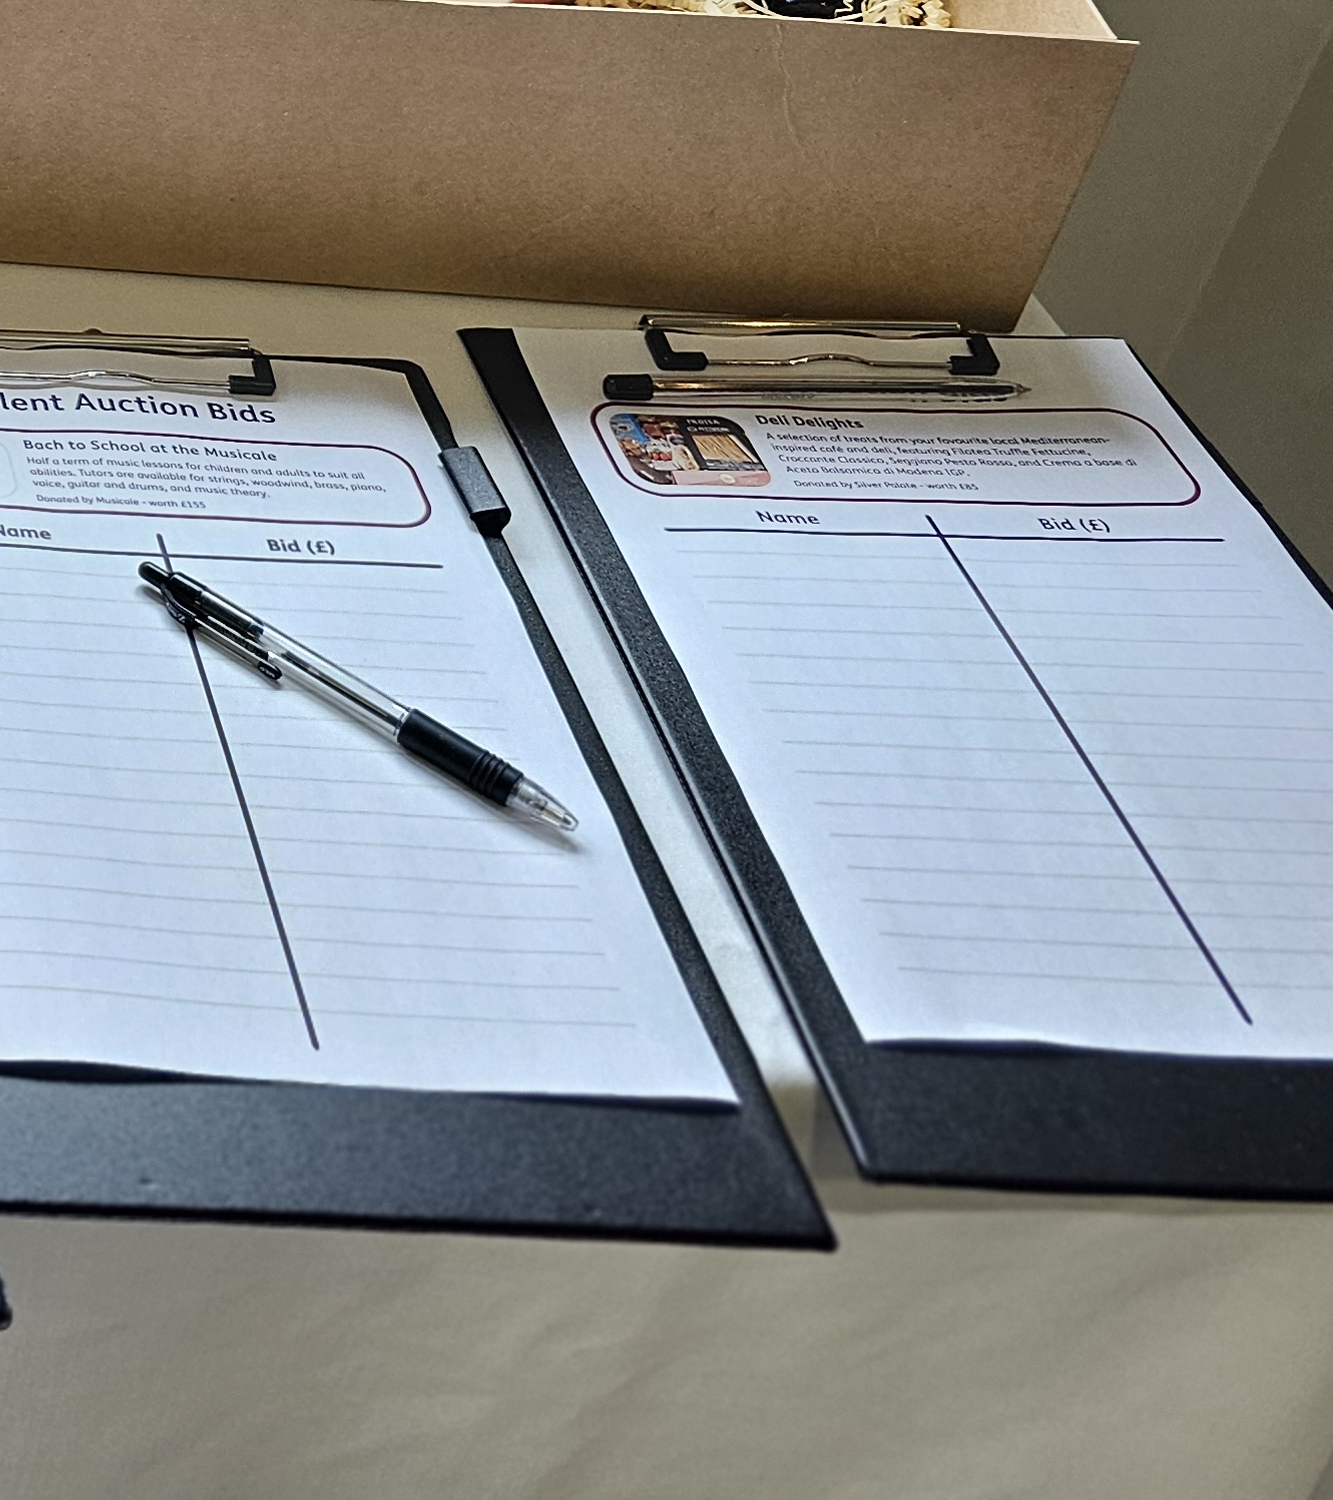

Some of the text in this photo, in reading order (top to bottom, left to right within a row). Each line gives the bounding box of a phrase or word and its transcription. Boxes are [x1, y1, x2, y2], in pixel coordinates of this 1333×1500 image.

[75, 394, 199, 418] Auction
[207, 403, 275, 423] Bids
[755, 415, 864, 430] Deli Delights
[23, 440, 277, 461] Bach to School at the Musicale
[755, 511, 1110, 533] Name Bid (£)
[266, 539, 301, 552] Bid
[307, 540, 335, 555] (£)
